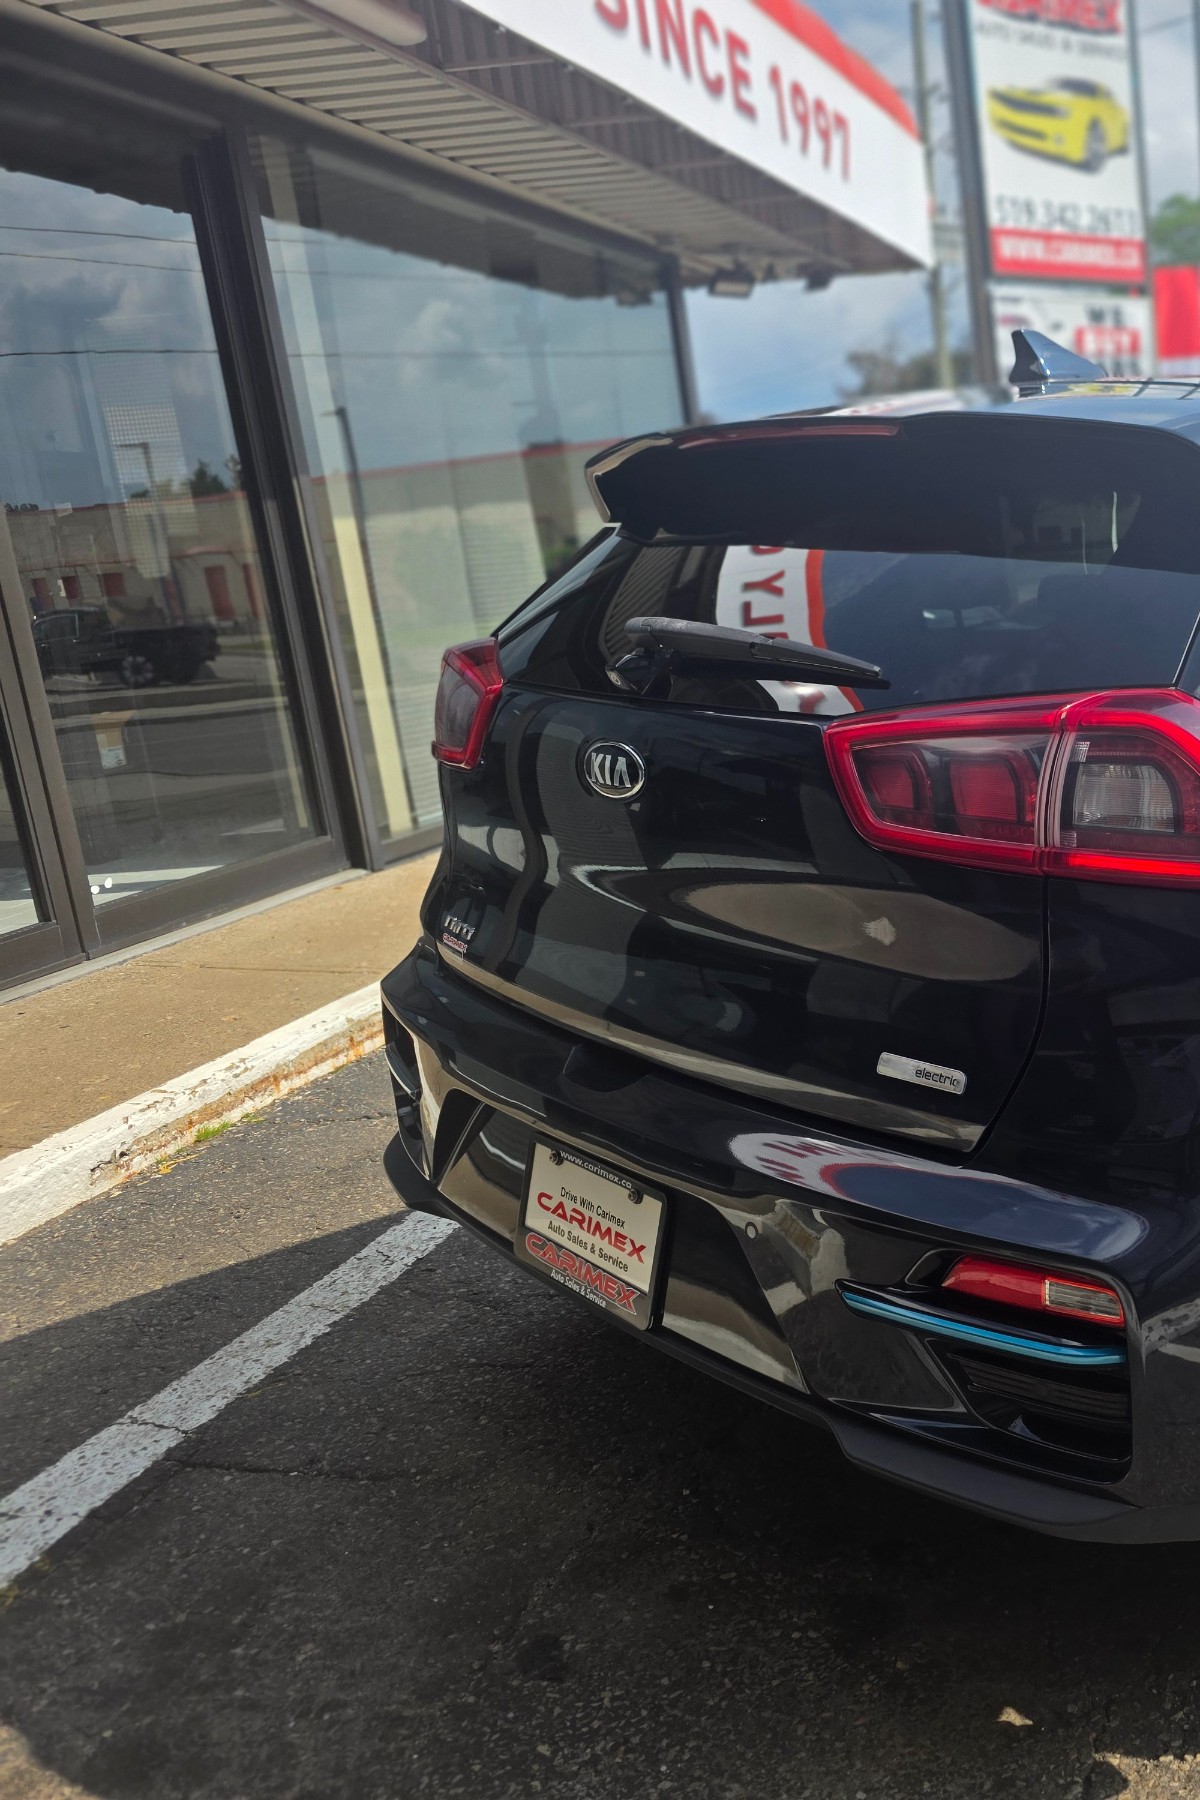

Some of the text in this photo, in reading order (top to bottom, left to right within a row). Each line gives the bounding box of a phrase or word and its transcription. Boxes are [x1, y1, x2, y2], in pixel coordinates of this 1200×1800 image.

[768, 63, 852, 182] 1997
[590, 752, 632, 788] KIA
[915, 1068, 957, 1086] electric
[559, 1150, 633, 1190] www.carimex.ca
[537, 1191, 647, 1264] CARIMEX
[560, 1186, 626, 1229] Drive With Carimex
[547, 1220, 629, 1273] Auto Sales & Service
[525, 1231, 641, 1316] CARIMEX
[550, 1268, 564, 1285] Auto
[564, 1276, 580, 1293] Sales
[586, 1289, 607, 1309] Service
